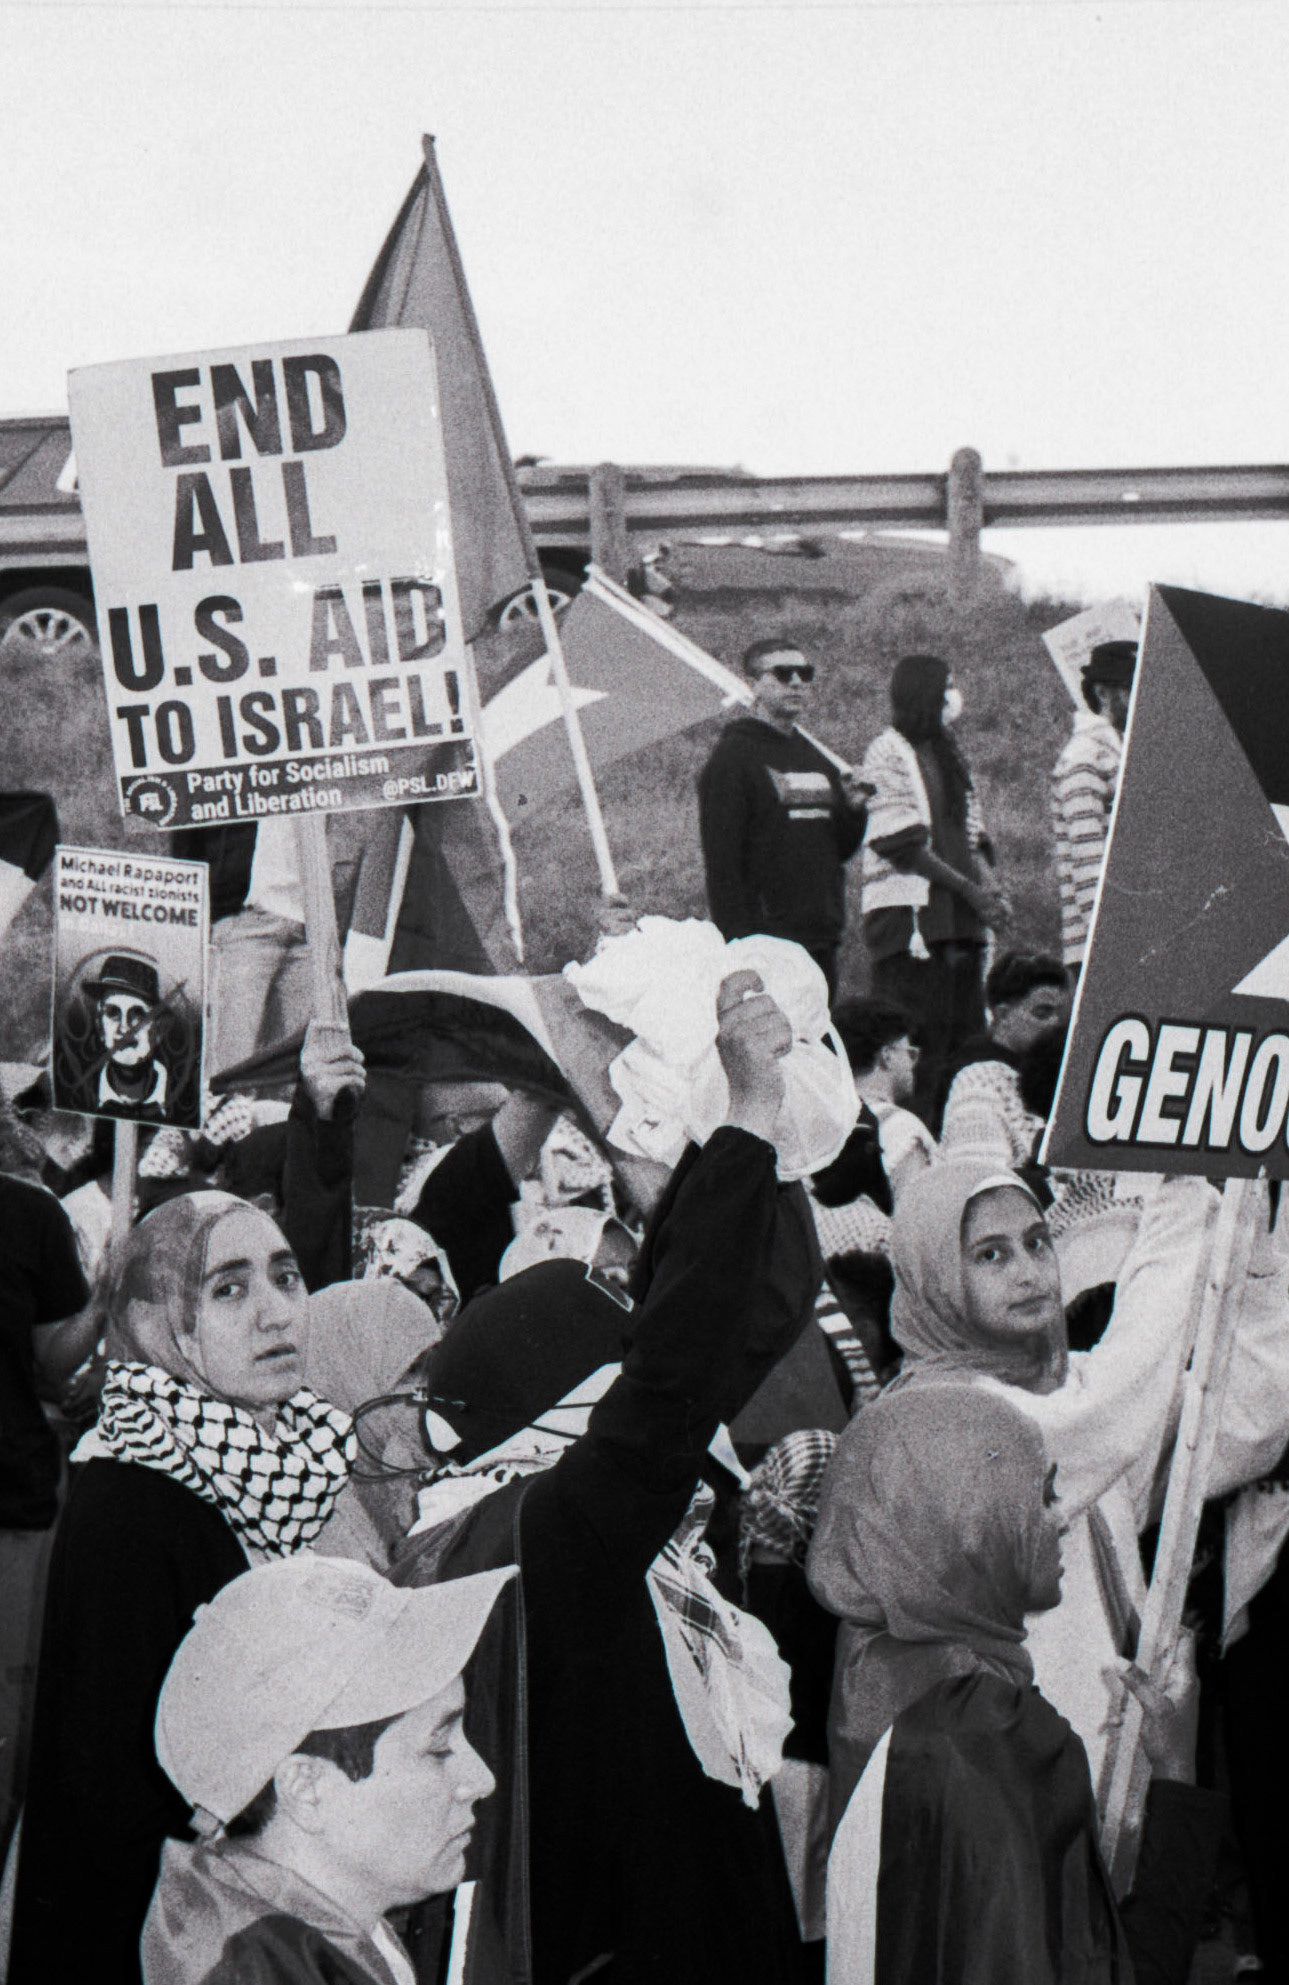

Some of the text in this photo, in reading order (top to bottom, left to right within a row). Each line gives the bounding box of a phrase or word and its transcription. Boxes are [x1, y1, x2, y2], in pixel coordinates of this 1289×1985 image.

[151, 354, 347, 468] END
[172, 460, 338, 571] ALL
[108, 576, 447, 692] U.S. AID
[116, 670, 464, 768] TO ISRAEL!
[187, 754, 389, 796] Party for Socialism
[191, 795, 229, 820] and
[235, 786, 342, 816] Liberation
[60, 877, 199, 903] and ALL racist zionists
[61, 856, 199, 886] Michael Rapaport
[60, 894, 198, 927] NOT WELCOME
[1086, 1018, 1289, 1152] GENO
